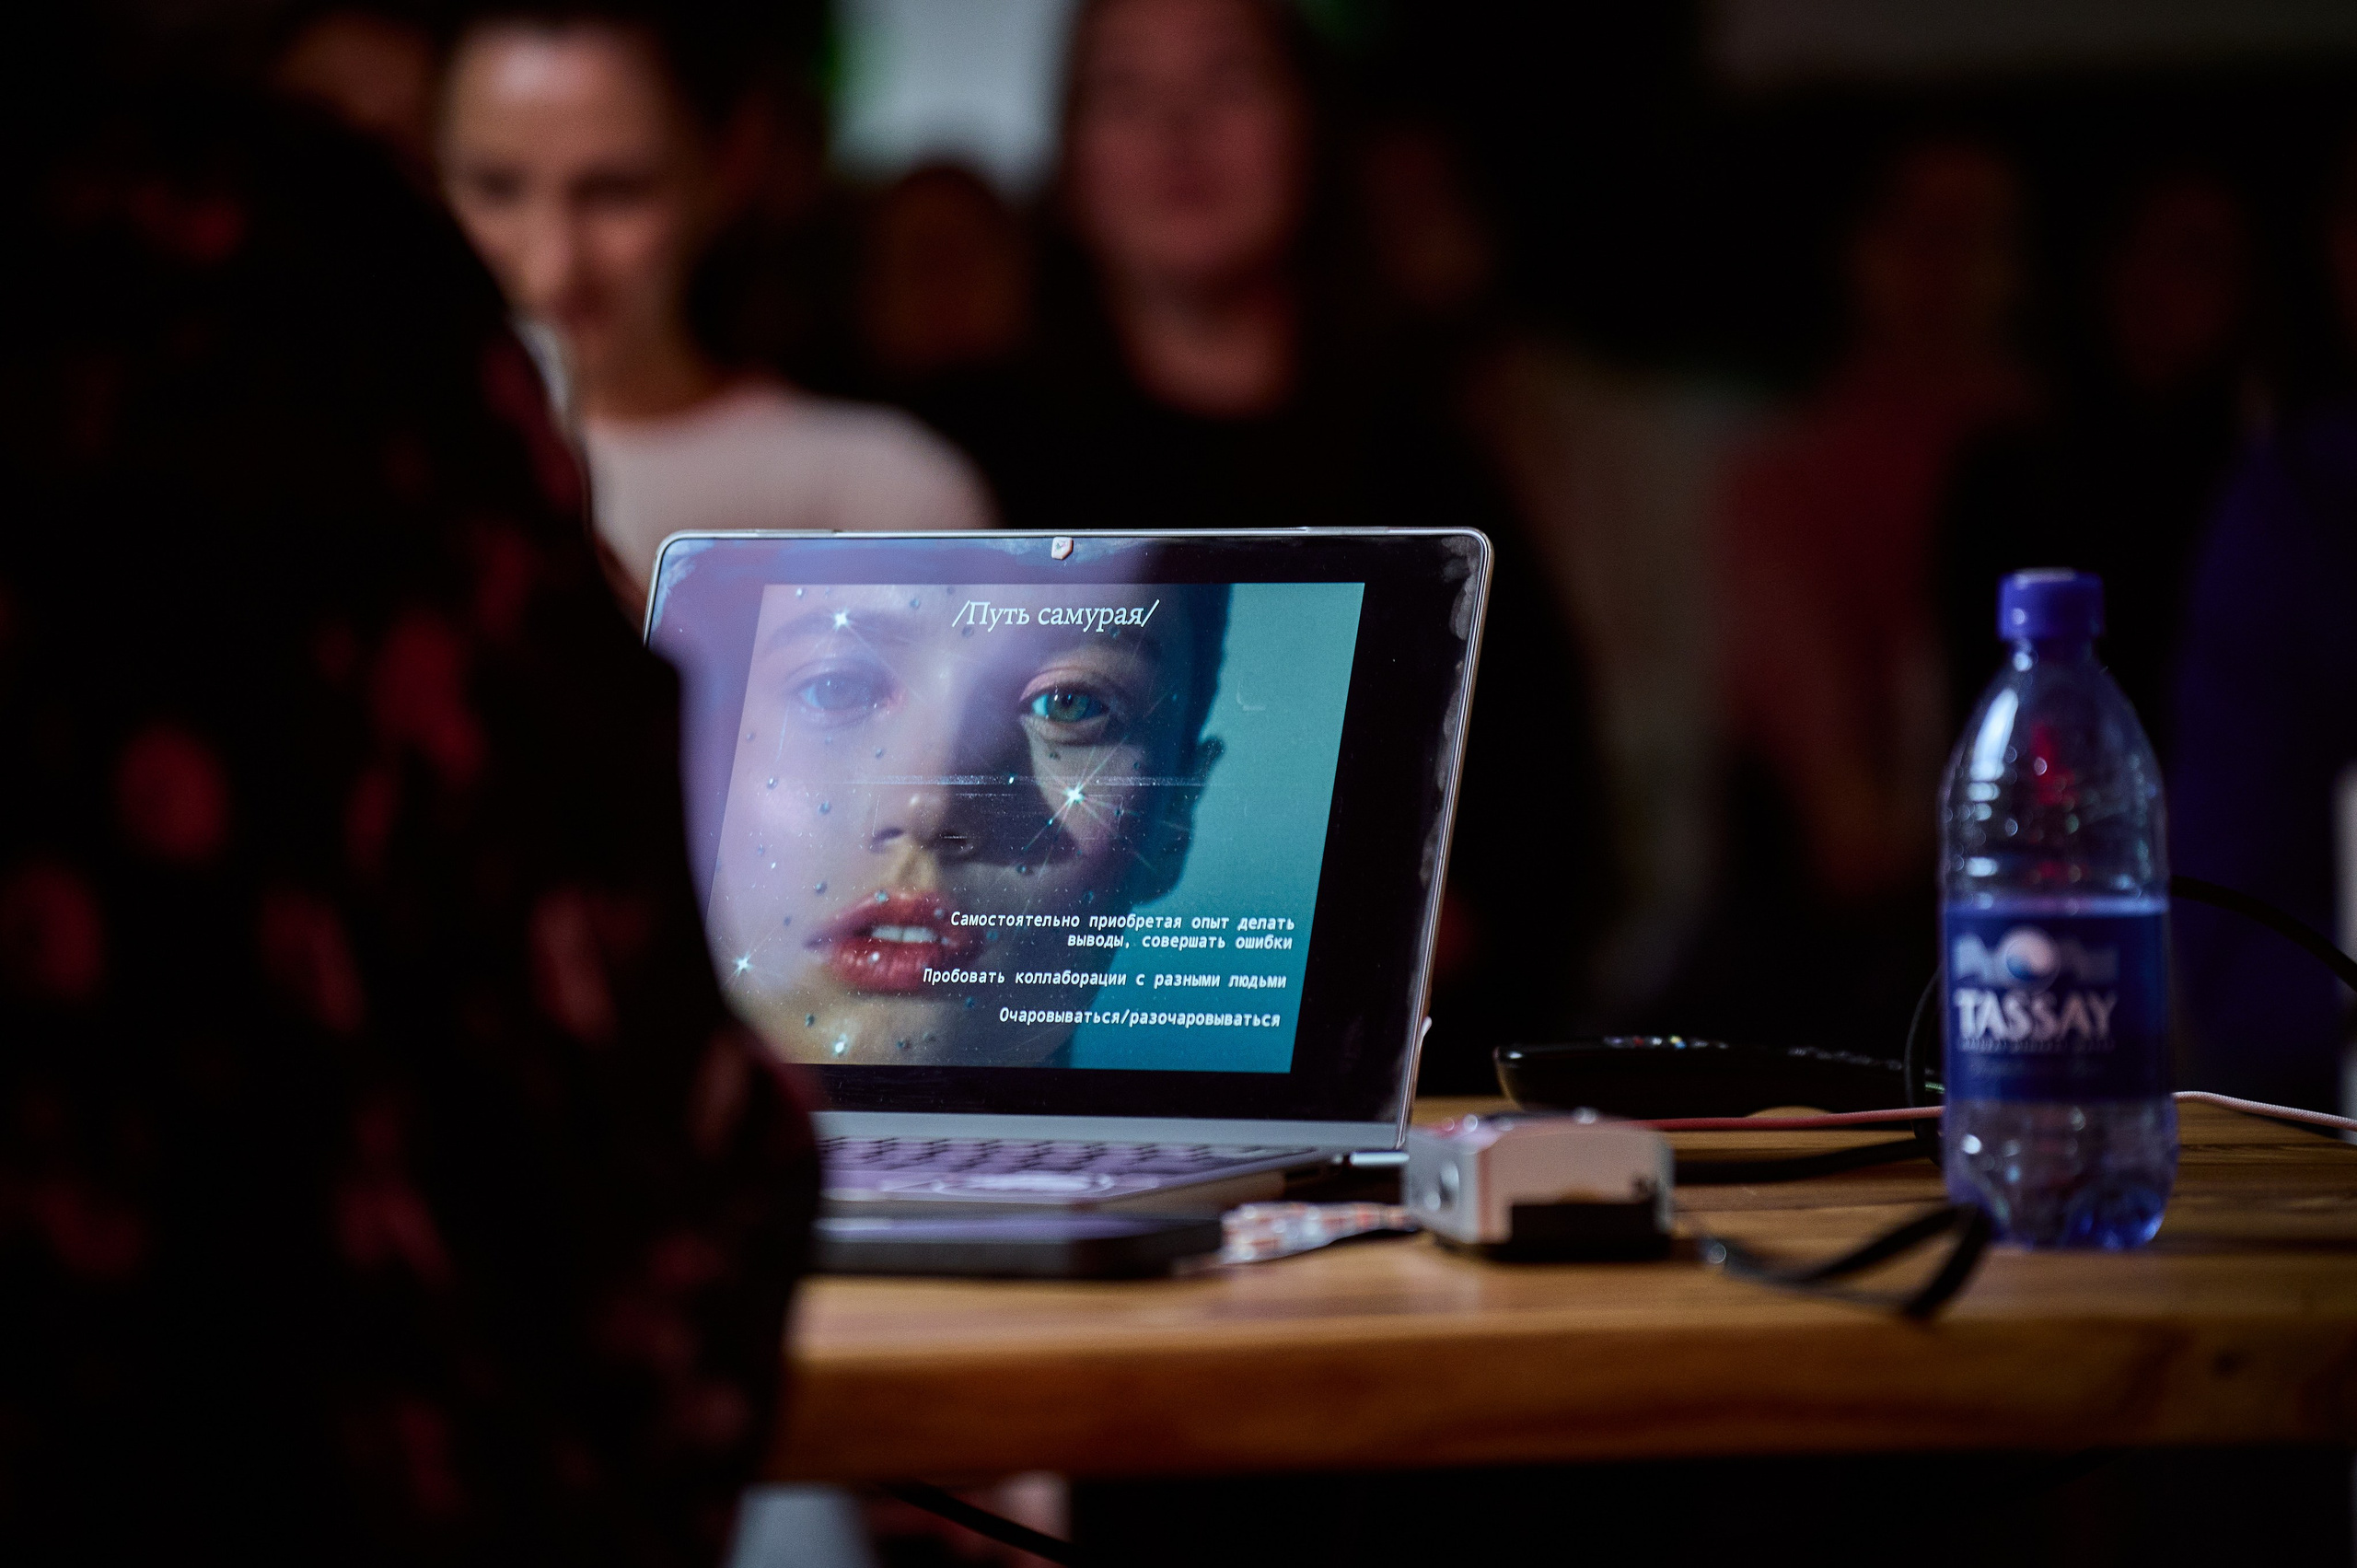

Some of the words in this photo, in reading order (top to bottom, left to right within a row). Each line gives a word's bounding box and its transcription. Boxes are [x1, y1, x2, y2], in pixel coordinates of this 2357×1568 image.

[951, 599, 1030, 633] /Путь
[1038, 598, 1160, 633] самурая/
[950, 911, 1080, 928] Самостоятельно
[1088, 913, 1181, 930] приобретая
[1191, 916, 1229, 930] опыт
[1237, 917, 1295, 932] делать
[1067, 934, 1130, 949] выводы,
[1142, 935, 1225, 949] совершать
[1235, 935, 1293, 950] ошибки
[923, 968, 1005, 984] Пробовать
[1015, 970, 1127, 988] коллаборации
[1135, 974, 1144, 987] с
[1154, 973, 1220, 989] разными
[1228, 975, 1287, 990] людьми
[999, 1007, 1281, 1028] Очаровываться/разочаровываться
[1954, 988, 2117, 1041] TASSAY
